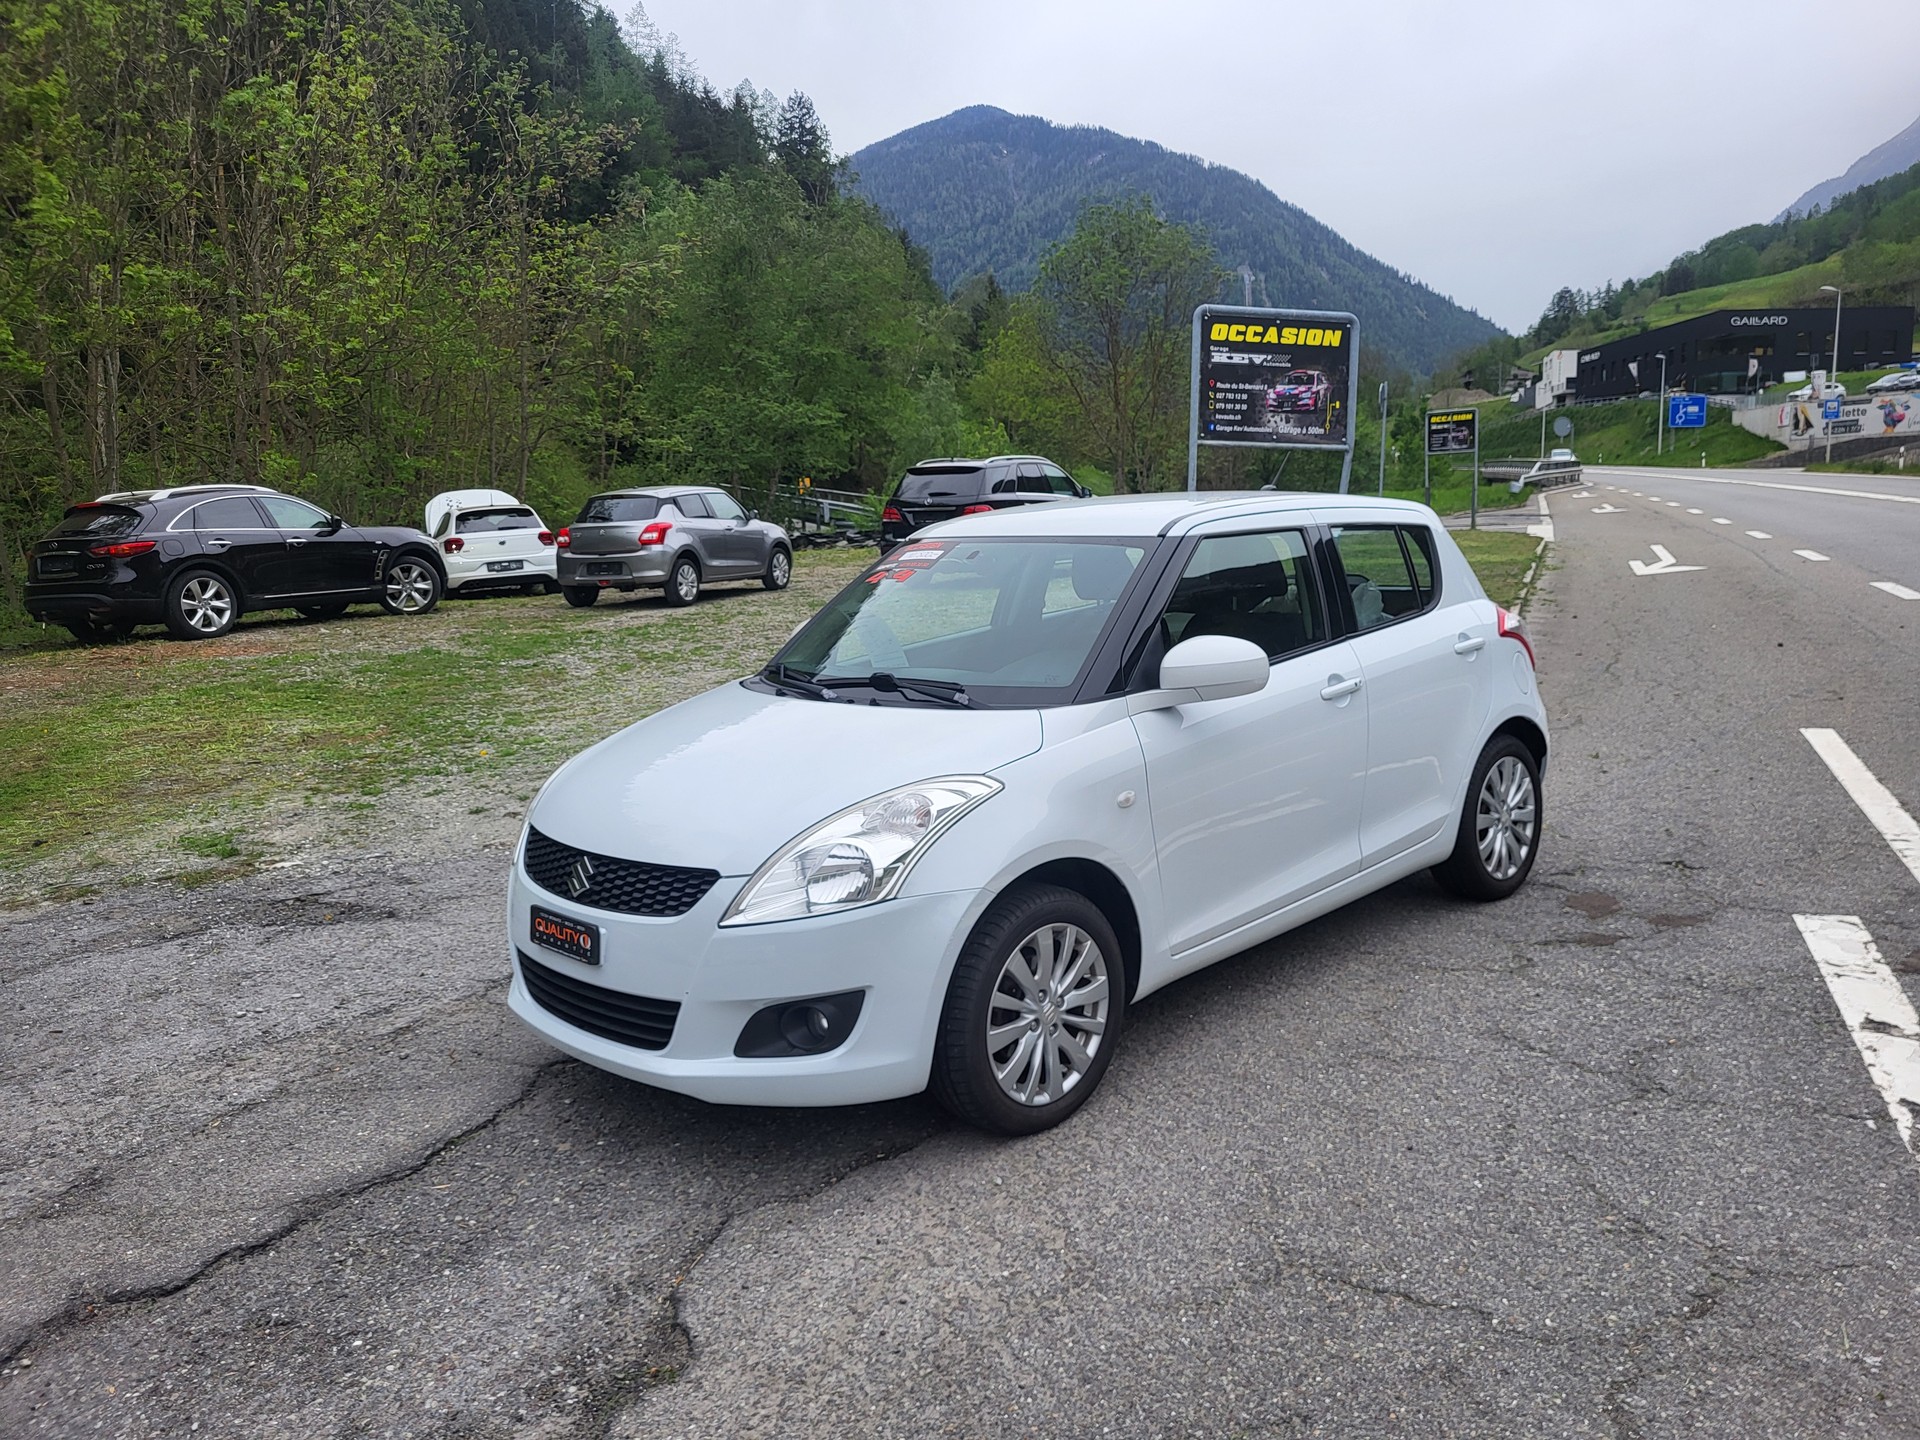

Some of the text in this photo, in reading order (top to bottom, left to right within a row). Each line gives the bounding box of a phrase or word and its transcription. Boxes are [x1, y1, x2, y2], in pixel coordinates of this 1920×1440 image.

[1730, 316, 1788, 326] GAILLARD
[1210, 323, 1342, 347] OCCASION
[1210, 345, 1229, 353] Garage
[1430, 413, 1473, 423] OCCASION
[1216, 424, 1233, 432] Garage
[1279, 425, 1302, 435] Garage
[1307, 426, 1325, 435] 500m
[535, 917, 580, 944] QUALITY
